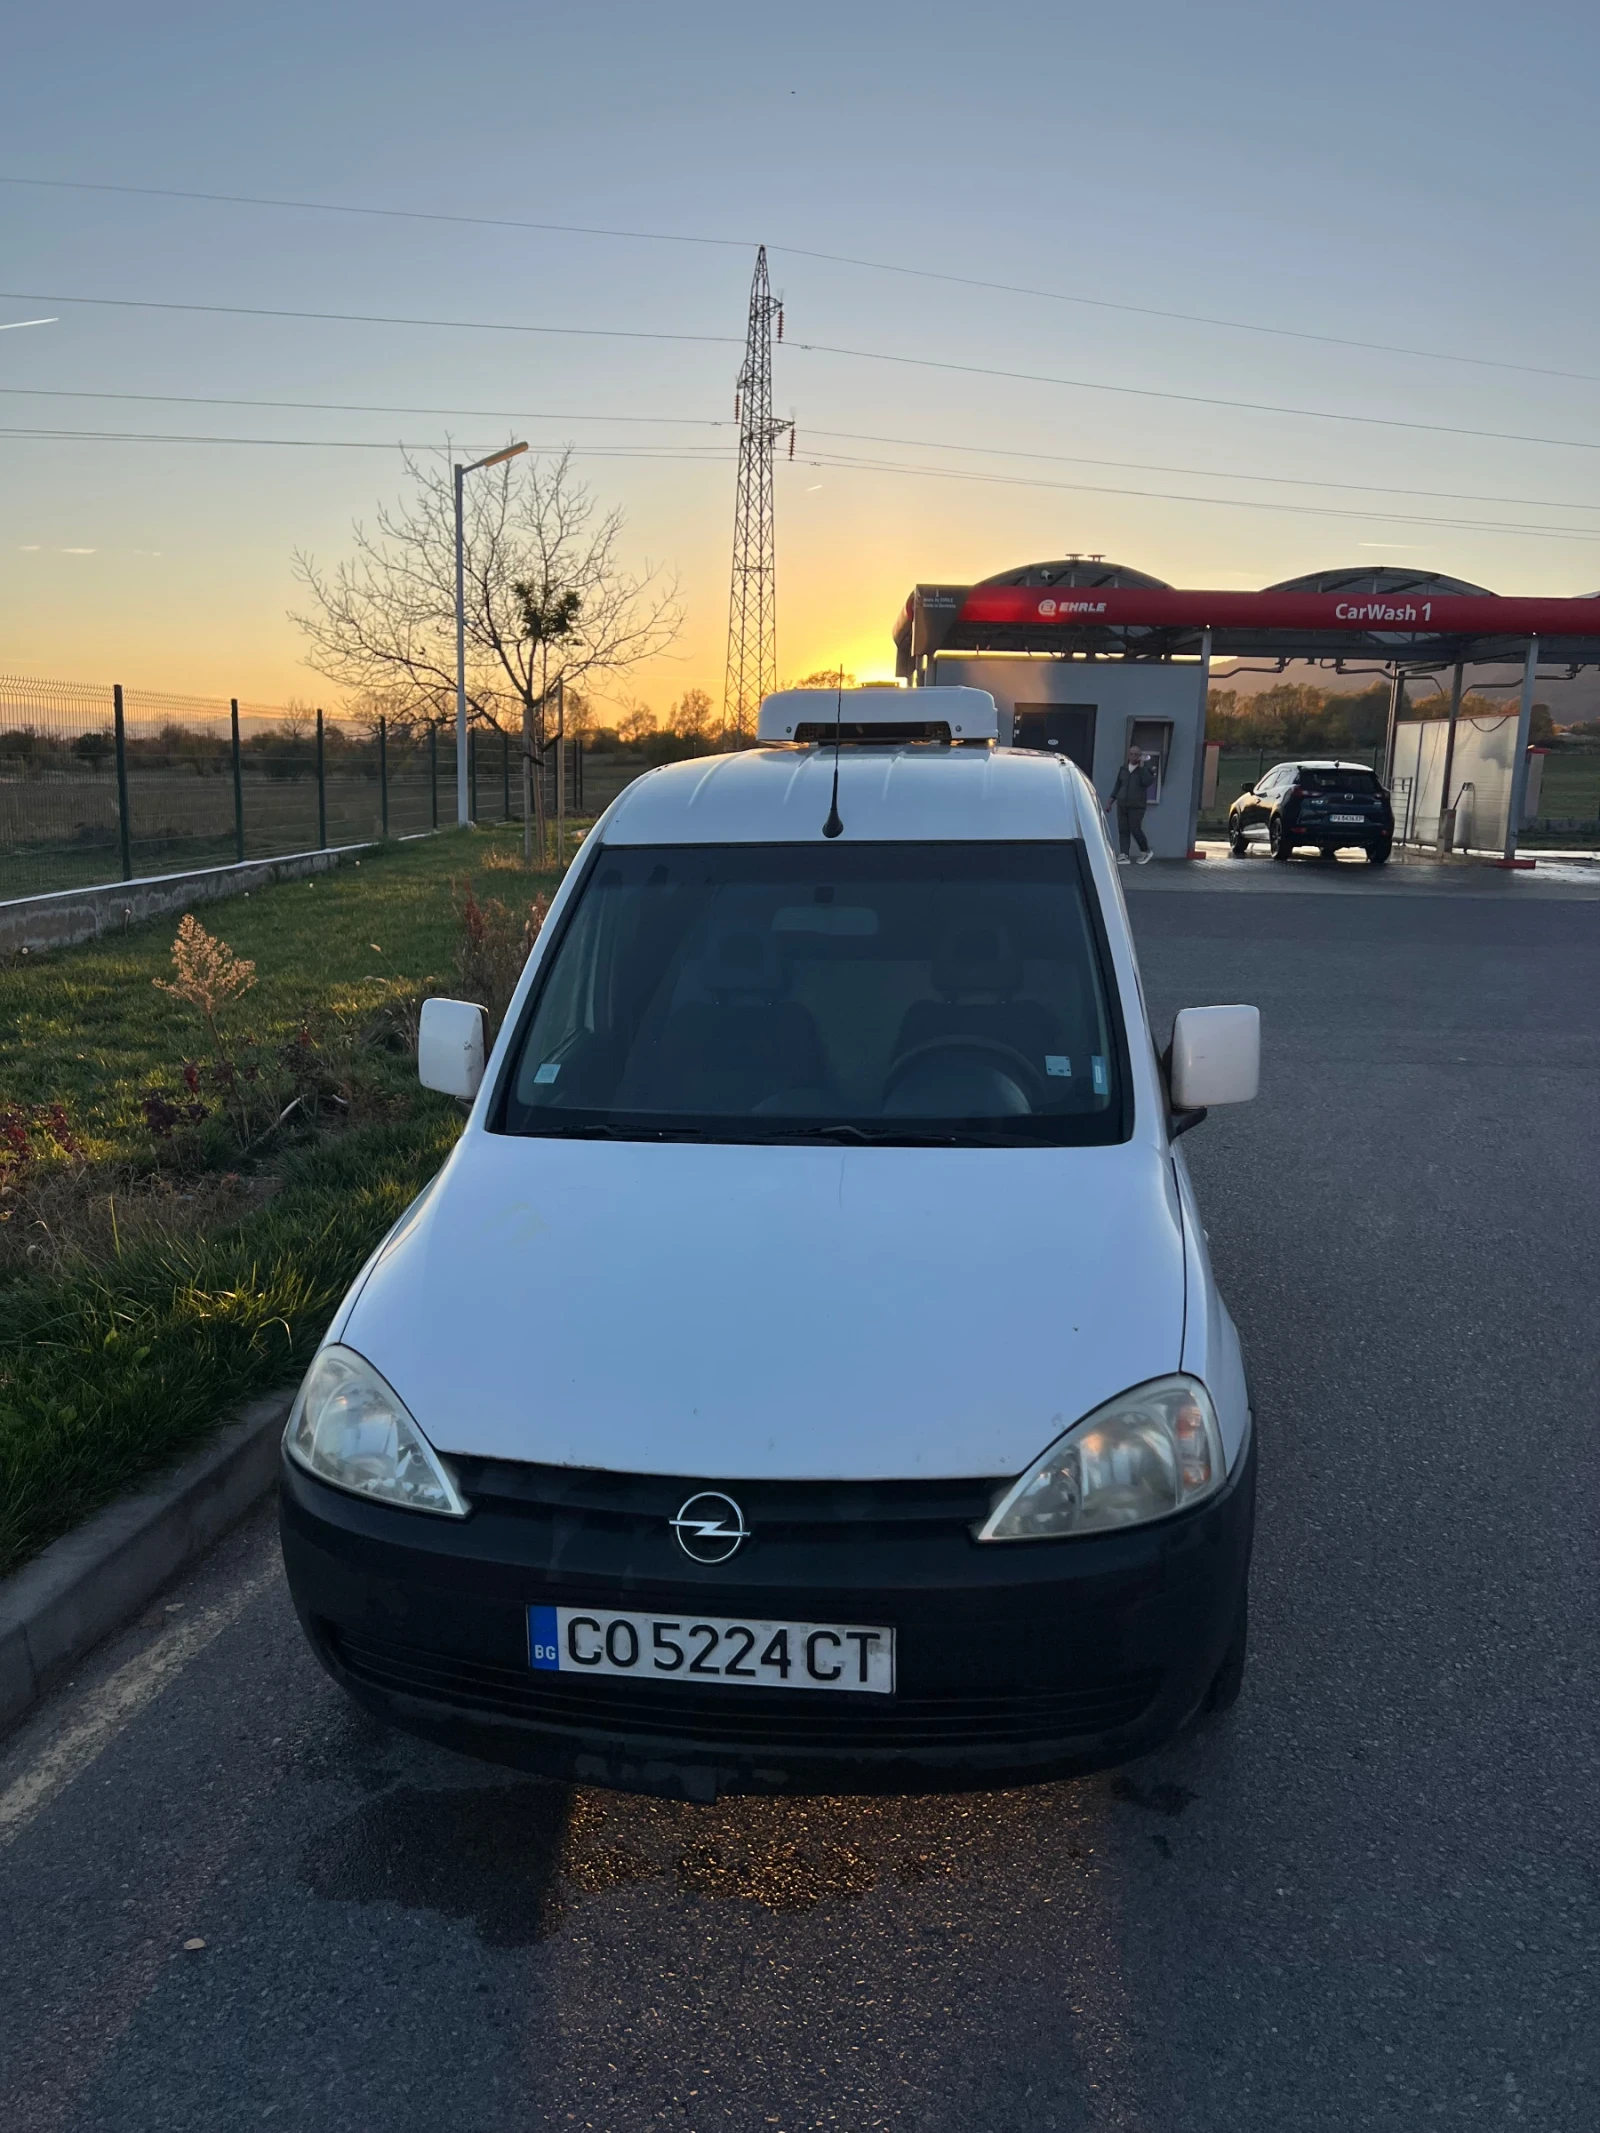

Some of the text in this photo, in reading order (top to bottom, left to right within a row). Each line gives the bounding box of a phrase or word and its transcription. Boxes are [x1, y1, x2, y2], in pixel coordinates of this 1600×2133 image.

[1059, 602, 1107, 613] EHRLE
[1335, 602, 1432, 621] CarWash 1
[534, 1644, 556, 1661] BG
[566, 1616, 881, 1683] CO 5224 CT
